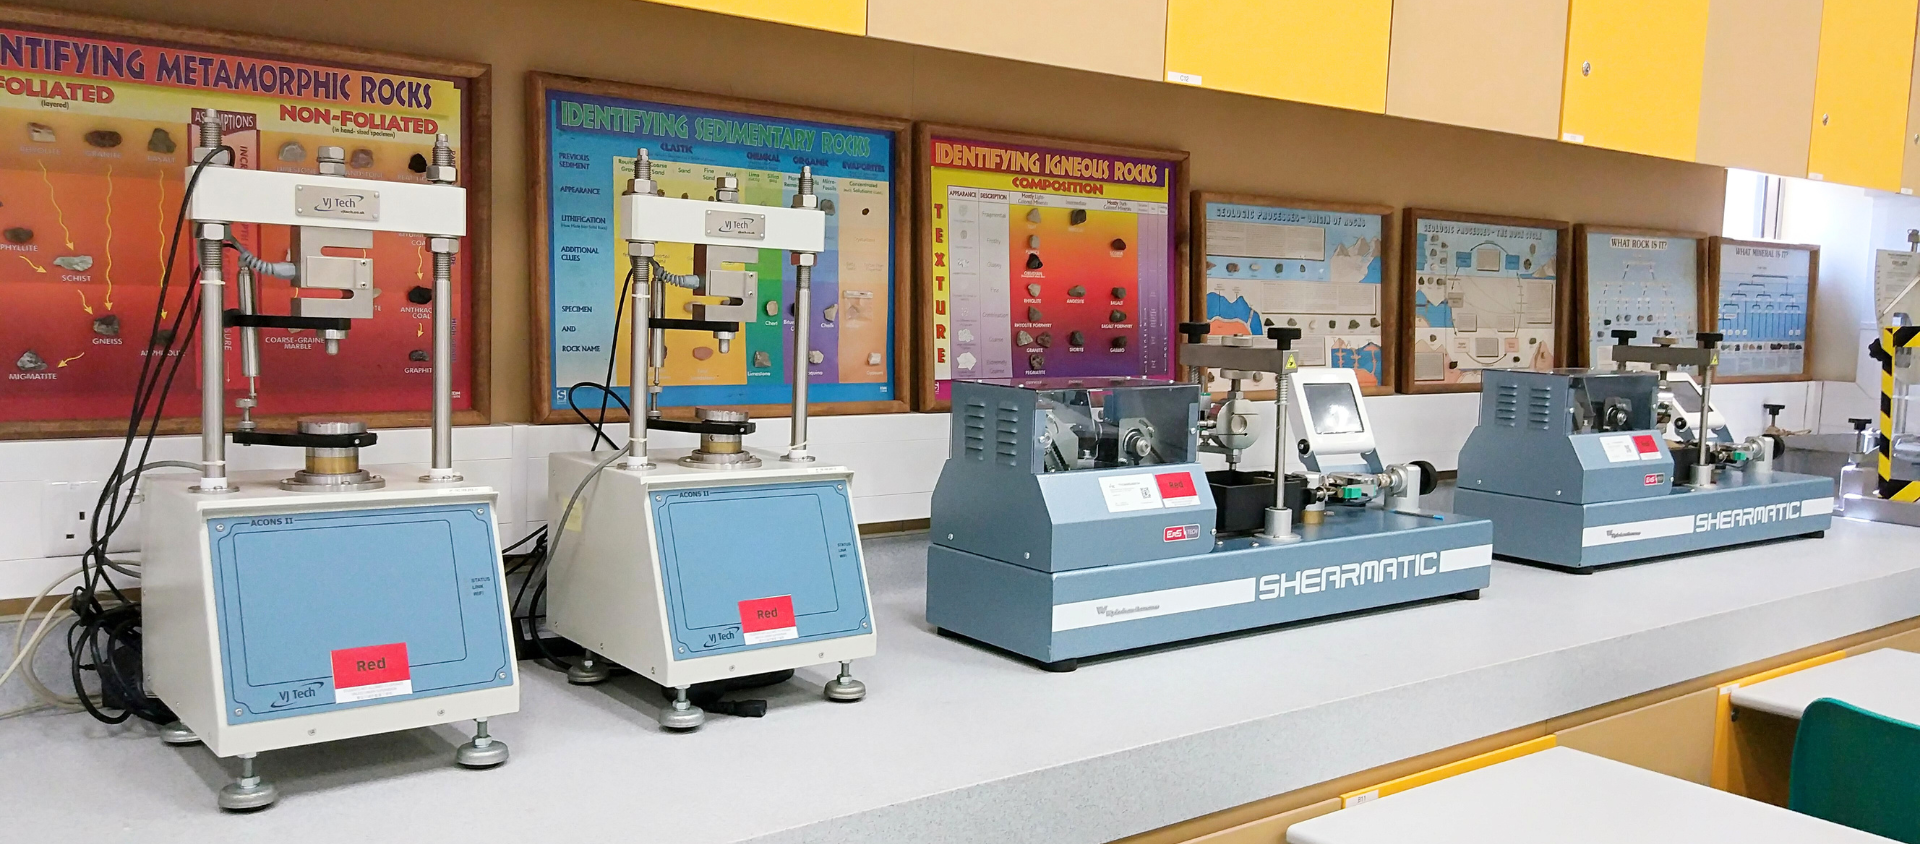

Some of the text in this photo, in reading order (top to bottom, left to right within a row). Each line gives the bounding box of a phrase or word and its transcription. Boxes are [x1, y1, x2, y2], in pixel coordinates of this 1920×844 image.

[156, 52, 350, 102] METAMORPHIC
[360, 75, 432, 110] ROCKS
[279, 104, 439, 135] NON-FOLIATED
[561, 101, 871, 158] IDENTIFYING SEDIMENTARY ROCKS
[559, 152, 590, 162] PREVIOUS
[559, 161, 590, 170] SEDIMENT
[935, 142, 1158, 184] IDENTIFYING IGNEOUS ROCKS
[560, 186, 600, 195] APPEARANCE
[1012, 177, 1104, 195] COMPOSITION
[322, 198, 356, 209] VJ Tech
[562, 214, 606, 224] LITHIFICATION
[724, 220, 748, 230] VJ Tech
[1611, 238, 1668, 249] WHAT ROCK IS IT?
[561, 246, 599, 255] ADDITIONAL
[1735, 248, 1751, 256] WHAT
[1752, 248, 1774, 258] MINERAL
[561, 254, 581, 262] CLUES
[934, 203, 946, 364] TEXTURE
[561, 305, 592, 313] SPECIMEN
[562, 345, 600, 353] ROCK NAME
[8, 372, 58, 380] MIGMATITE
[250, 517, 294, 527] ACONS II
[1695, 501, 1801, 533] SHEARMATIC
[1259, 551, 1438, 600] SHEARMATIC
[756, 608, 778, 620] Red
[708, 631, 734, 643] VJ Tech
[356, 657, 386, 672] Red
[279, 687, 316, 702] VJ Tech
